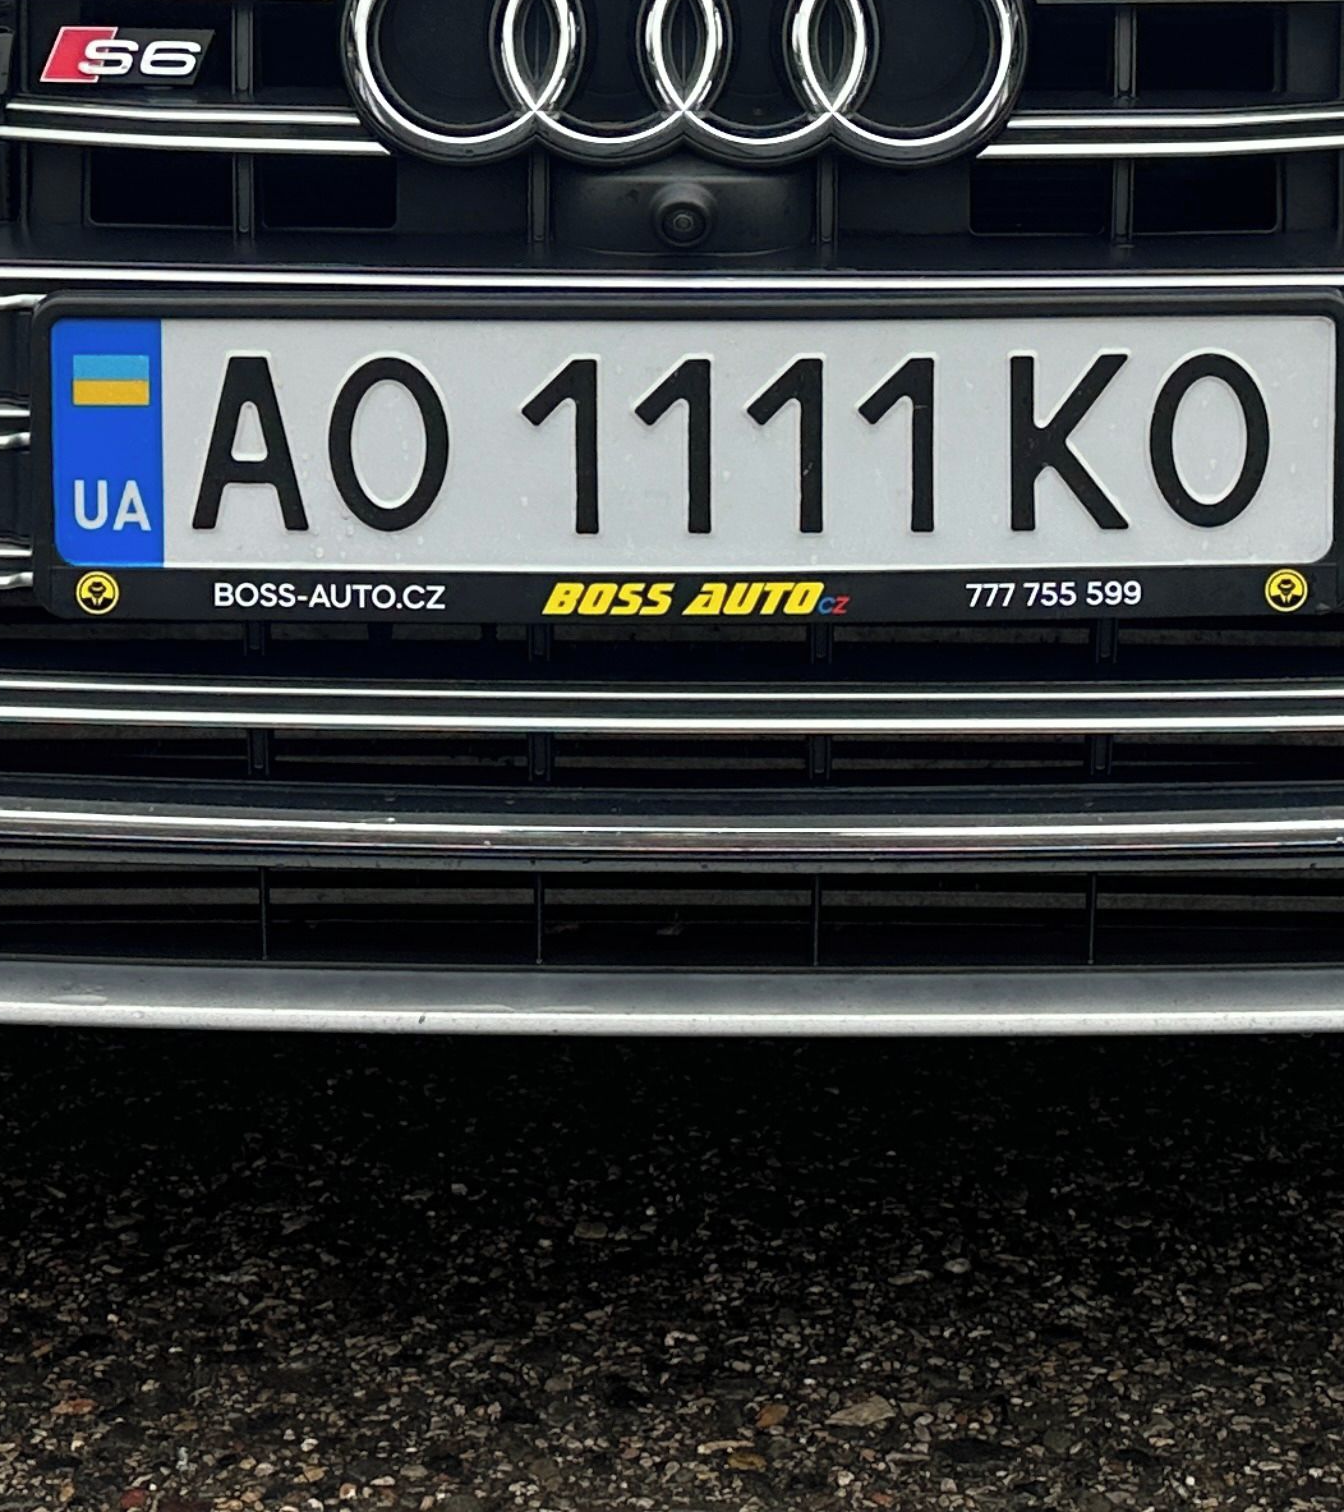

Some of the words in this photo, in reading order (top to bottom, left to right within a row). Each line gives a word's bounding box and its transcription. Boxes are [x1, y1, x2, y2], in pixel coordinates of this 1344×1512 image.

[77, 39, 203, 76] S6
[191, 354, 450, 533] AO
[521, 356, 935, 535] 1111
[1009, 352, 1271, 532] KO
[73, 480, 152, 531] UA
[214, 582, 446, 609] BOSS-AUTO.CZ
[542, 582, 675, 615] BOSS
[965, 583, 1016, 607] 777
[1023, 581, 1077, 606] 755
[1086, 580, 1142, 605] 599
